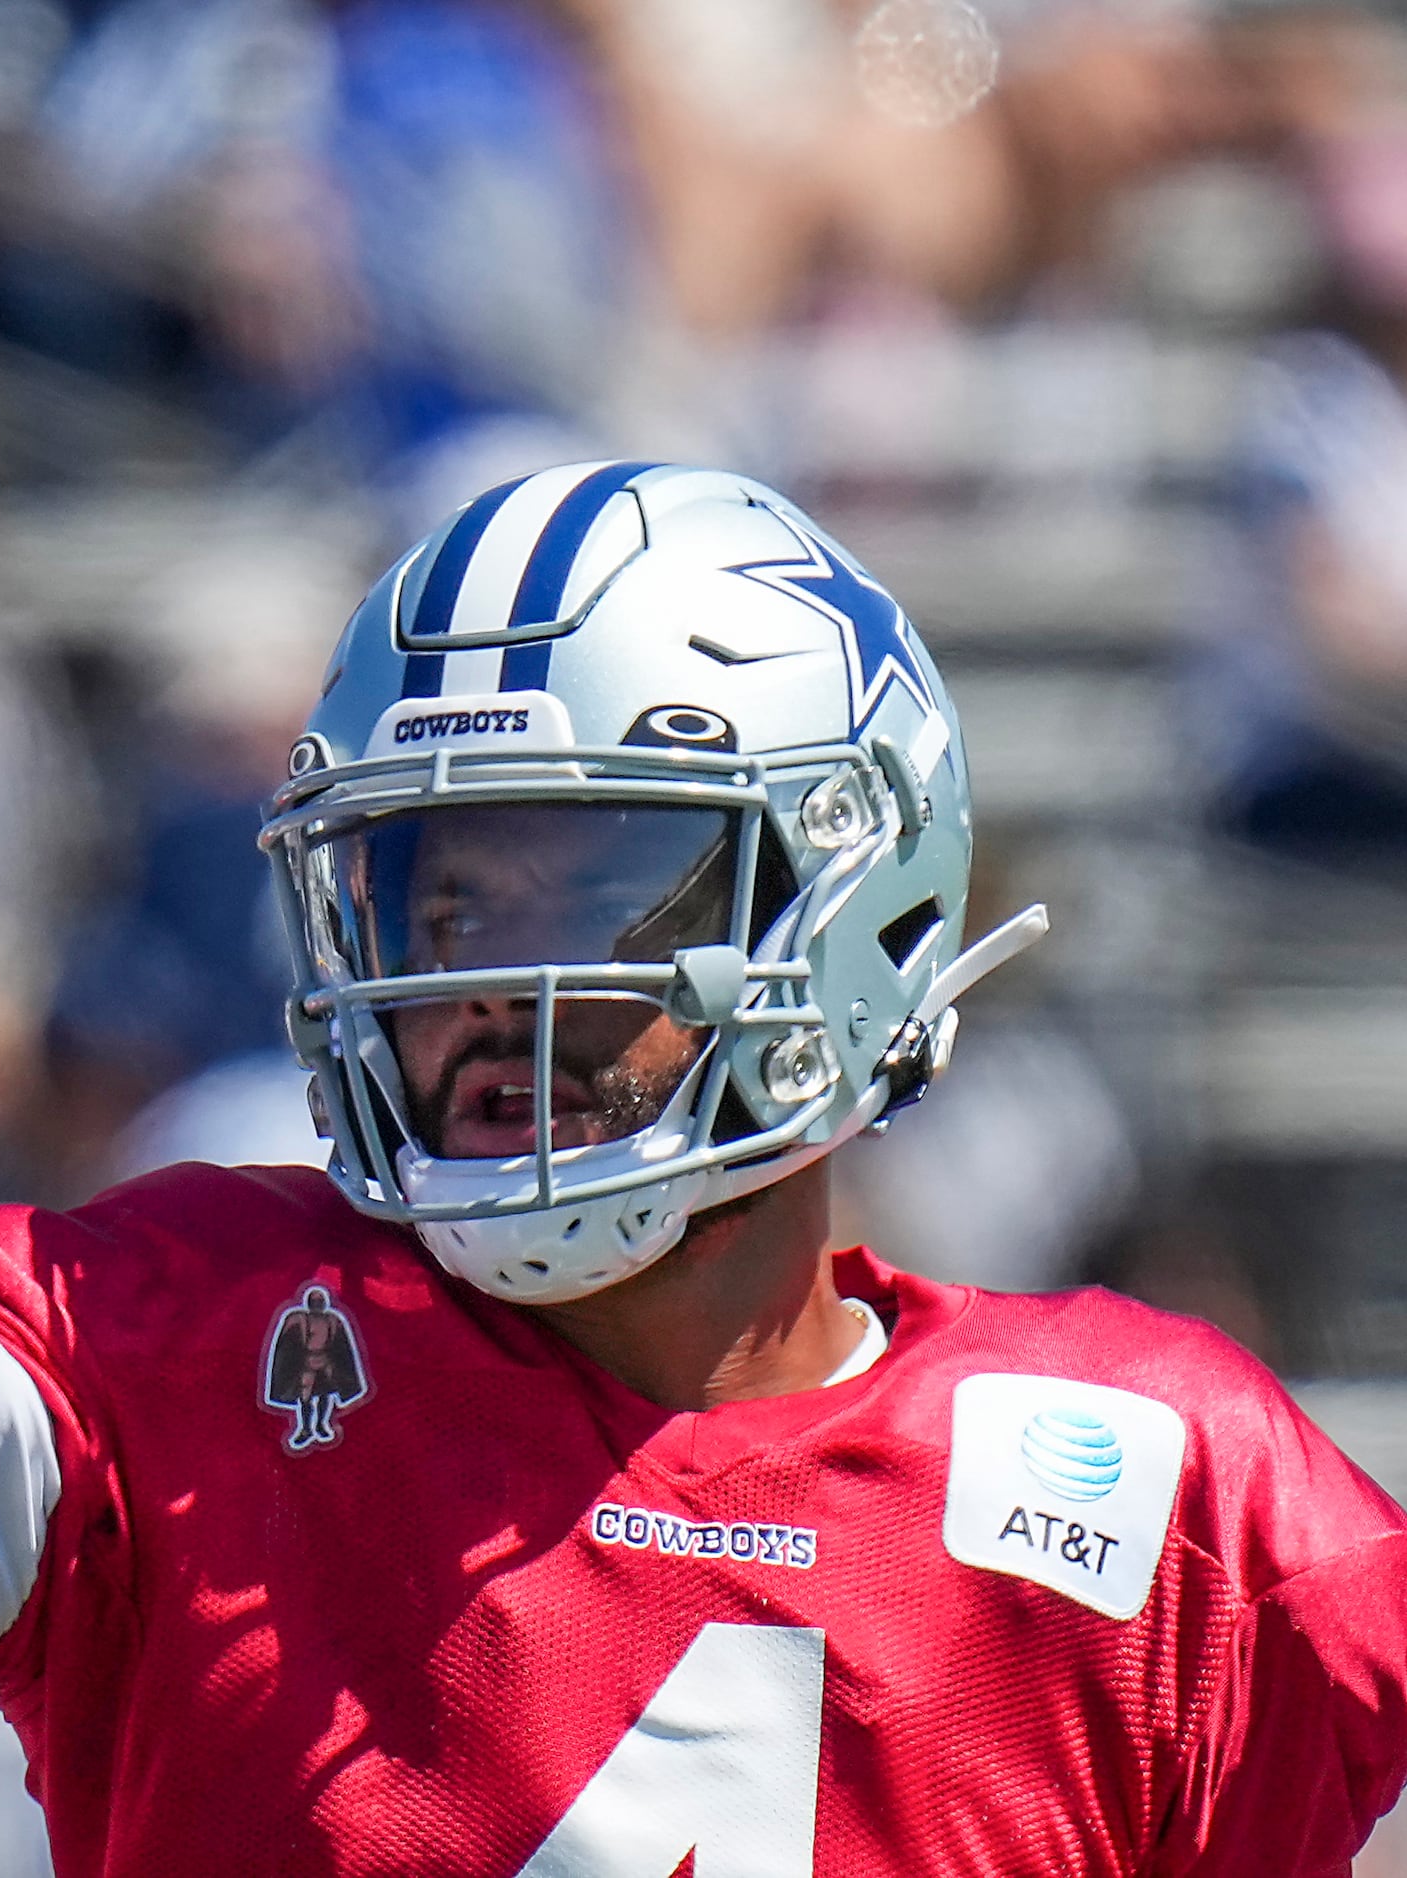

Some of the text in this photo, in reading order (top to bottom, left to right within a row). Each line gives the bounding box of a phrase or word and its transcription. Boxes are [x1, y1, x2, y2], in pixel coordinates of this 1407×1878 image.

[394, 709, 529, 744] COWBOYS
[593, 1502, 818, 1570] COWBOYS
[998, 1505, 1120, 1575] AT&T
